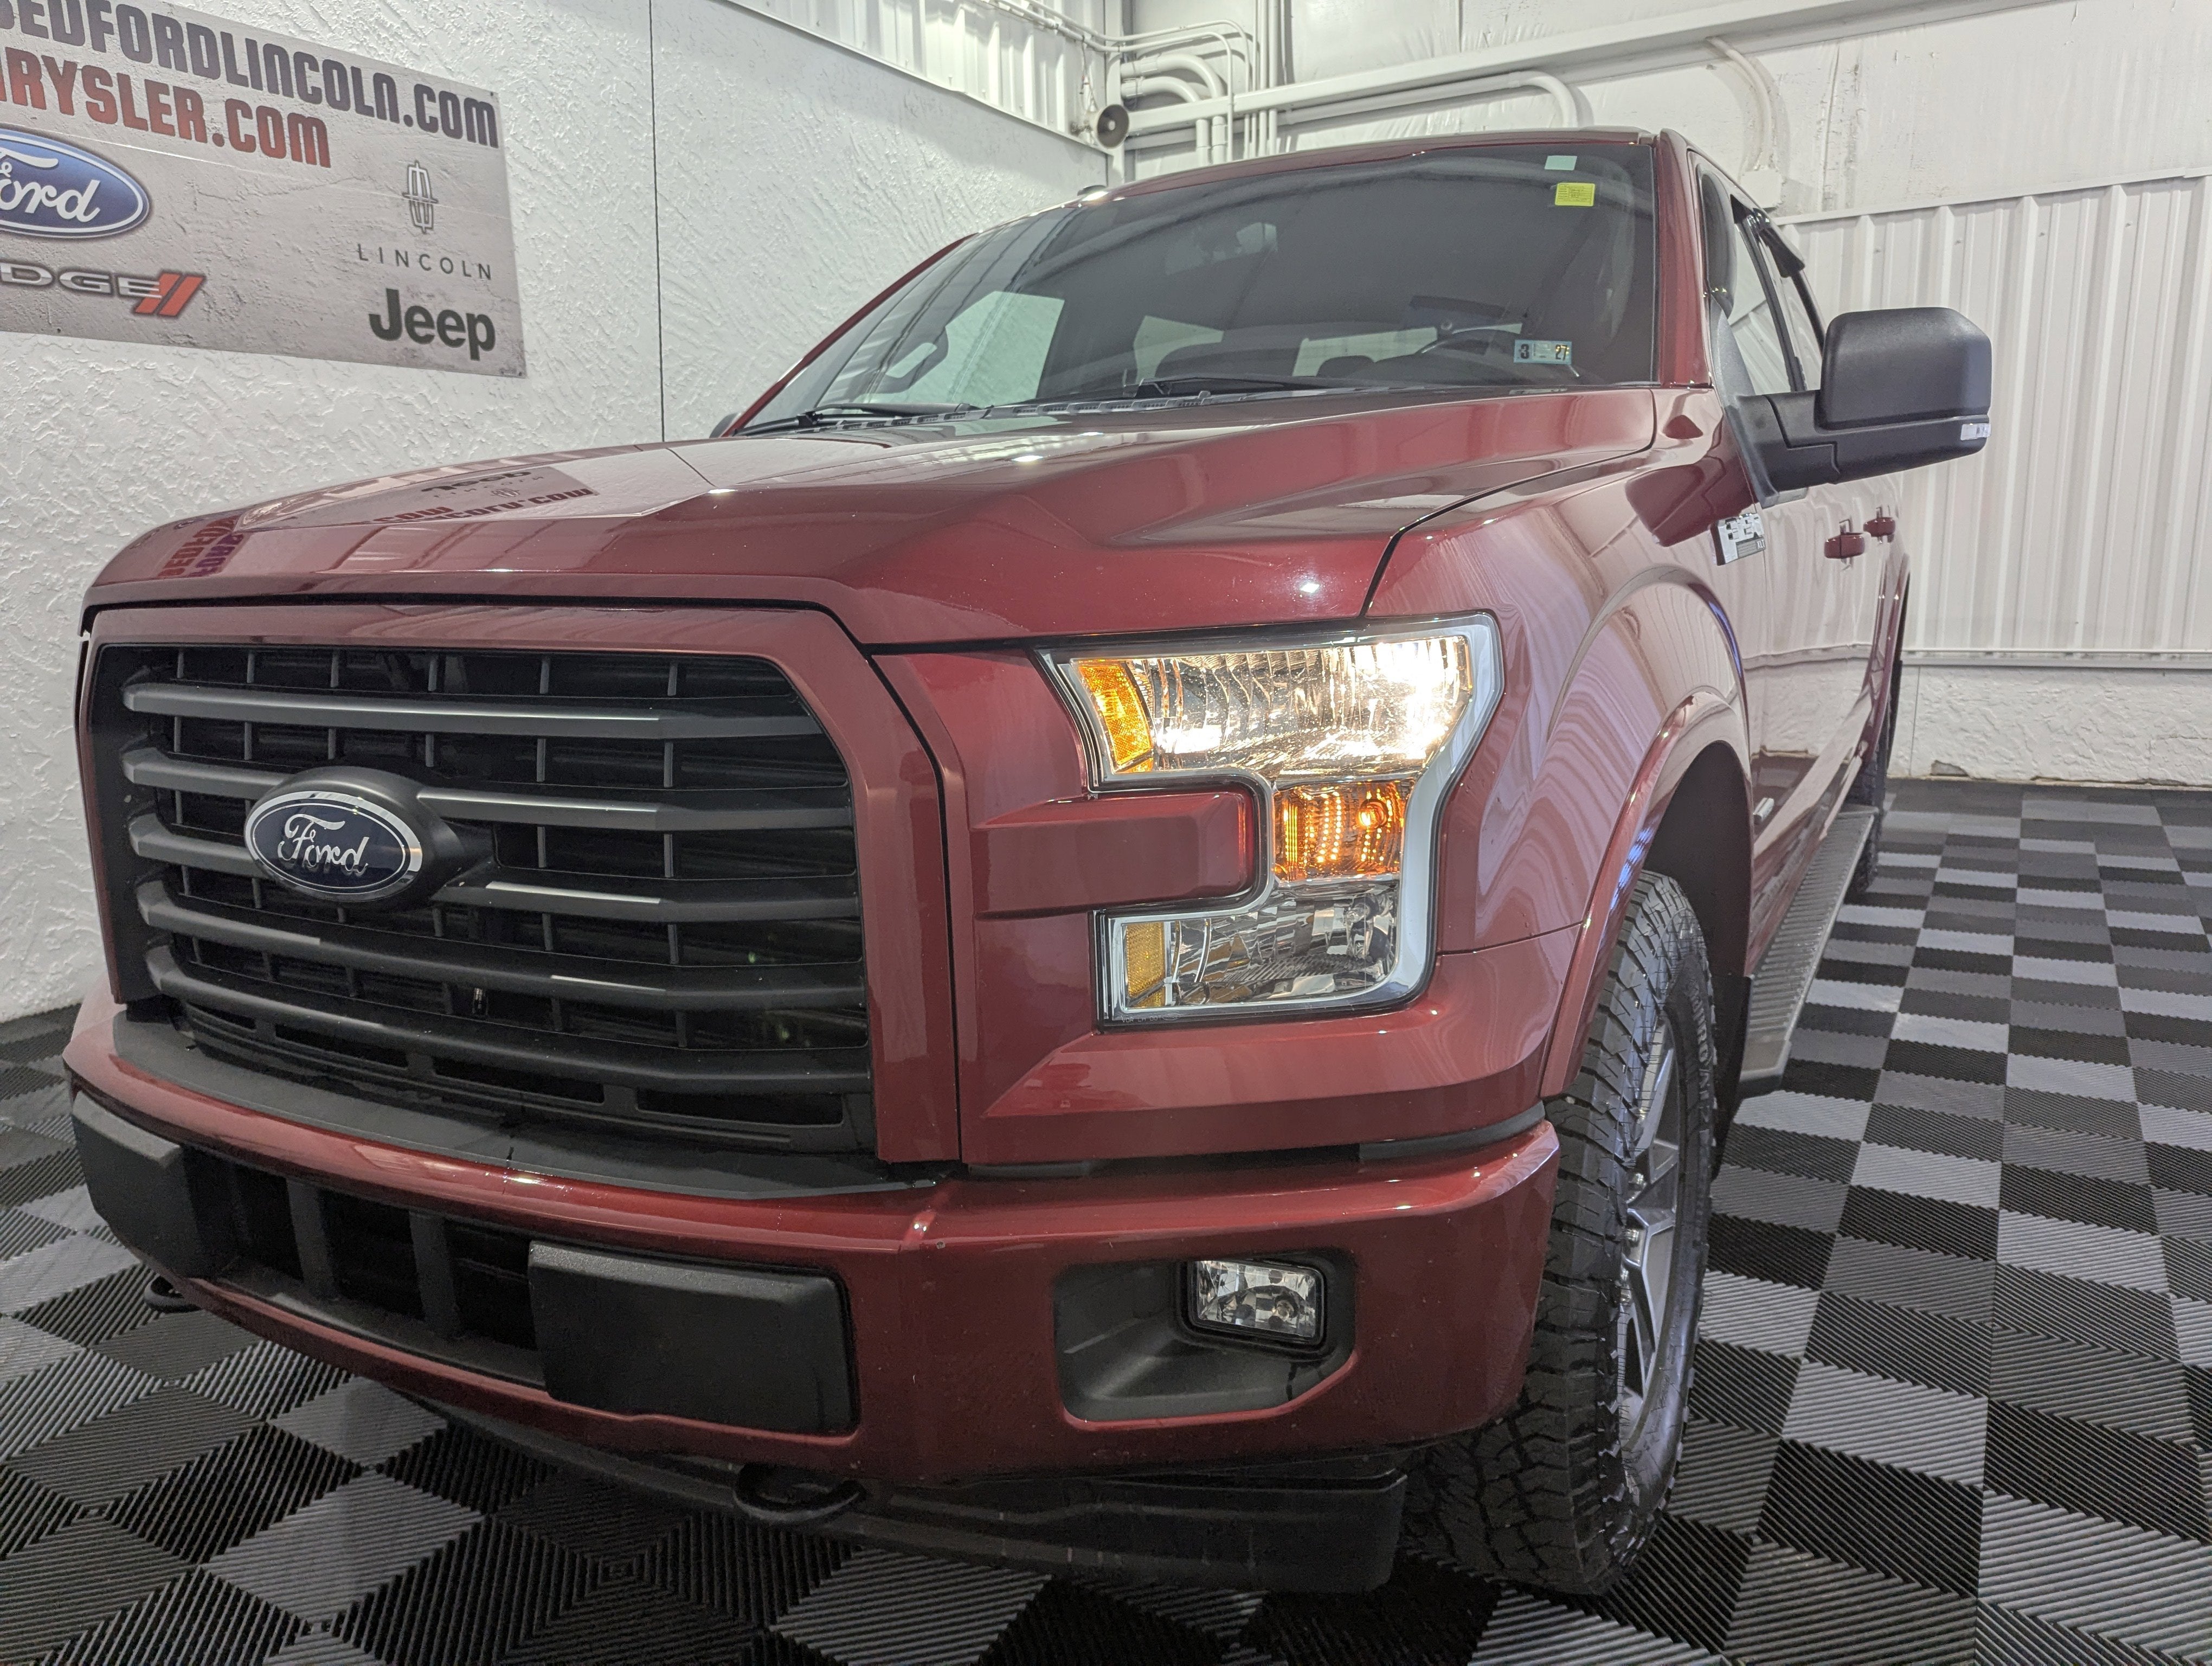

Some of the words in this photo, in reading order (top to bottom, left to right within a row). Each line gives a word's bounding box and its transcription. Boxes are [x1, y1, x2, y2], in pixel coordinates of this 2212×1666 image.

[0, 0, 498, 148] EDFORDLINCOLN.COM
[0, 47, 331, 168] RYSLER.COM
[357, 244, 491, 280] LINCOLN
[368, 288, 496, 361] Jeep
[1520, 343, 1529, 359] 3
[1756, 539, 1765, 549] XLT
[277, 813, 370, 874] Ford
